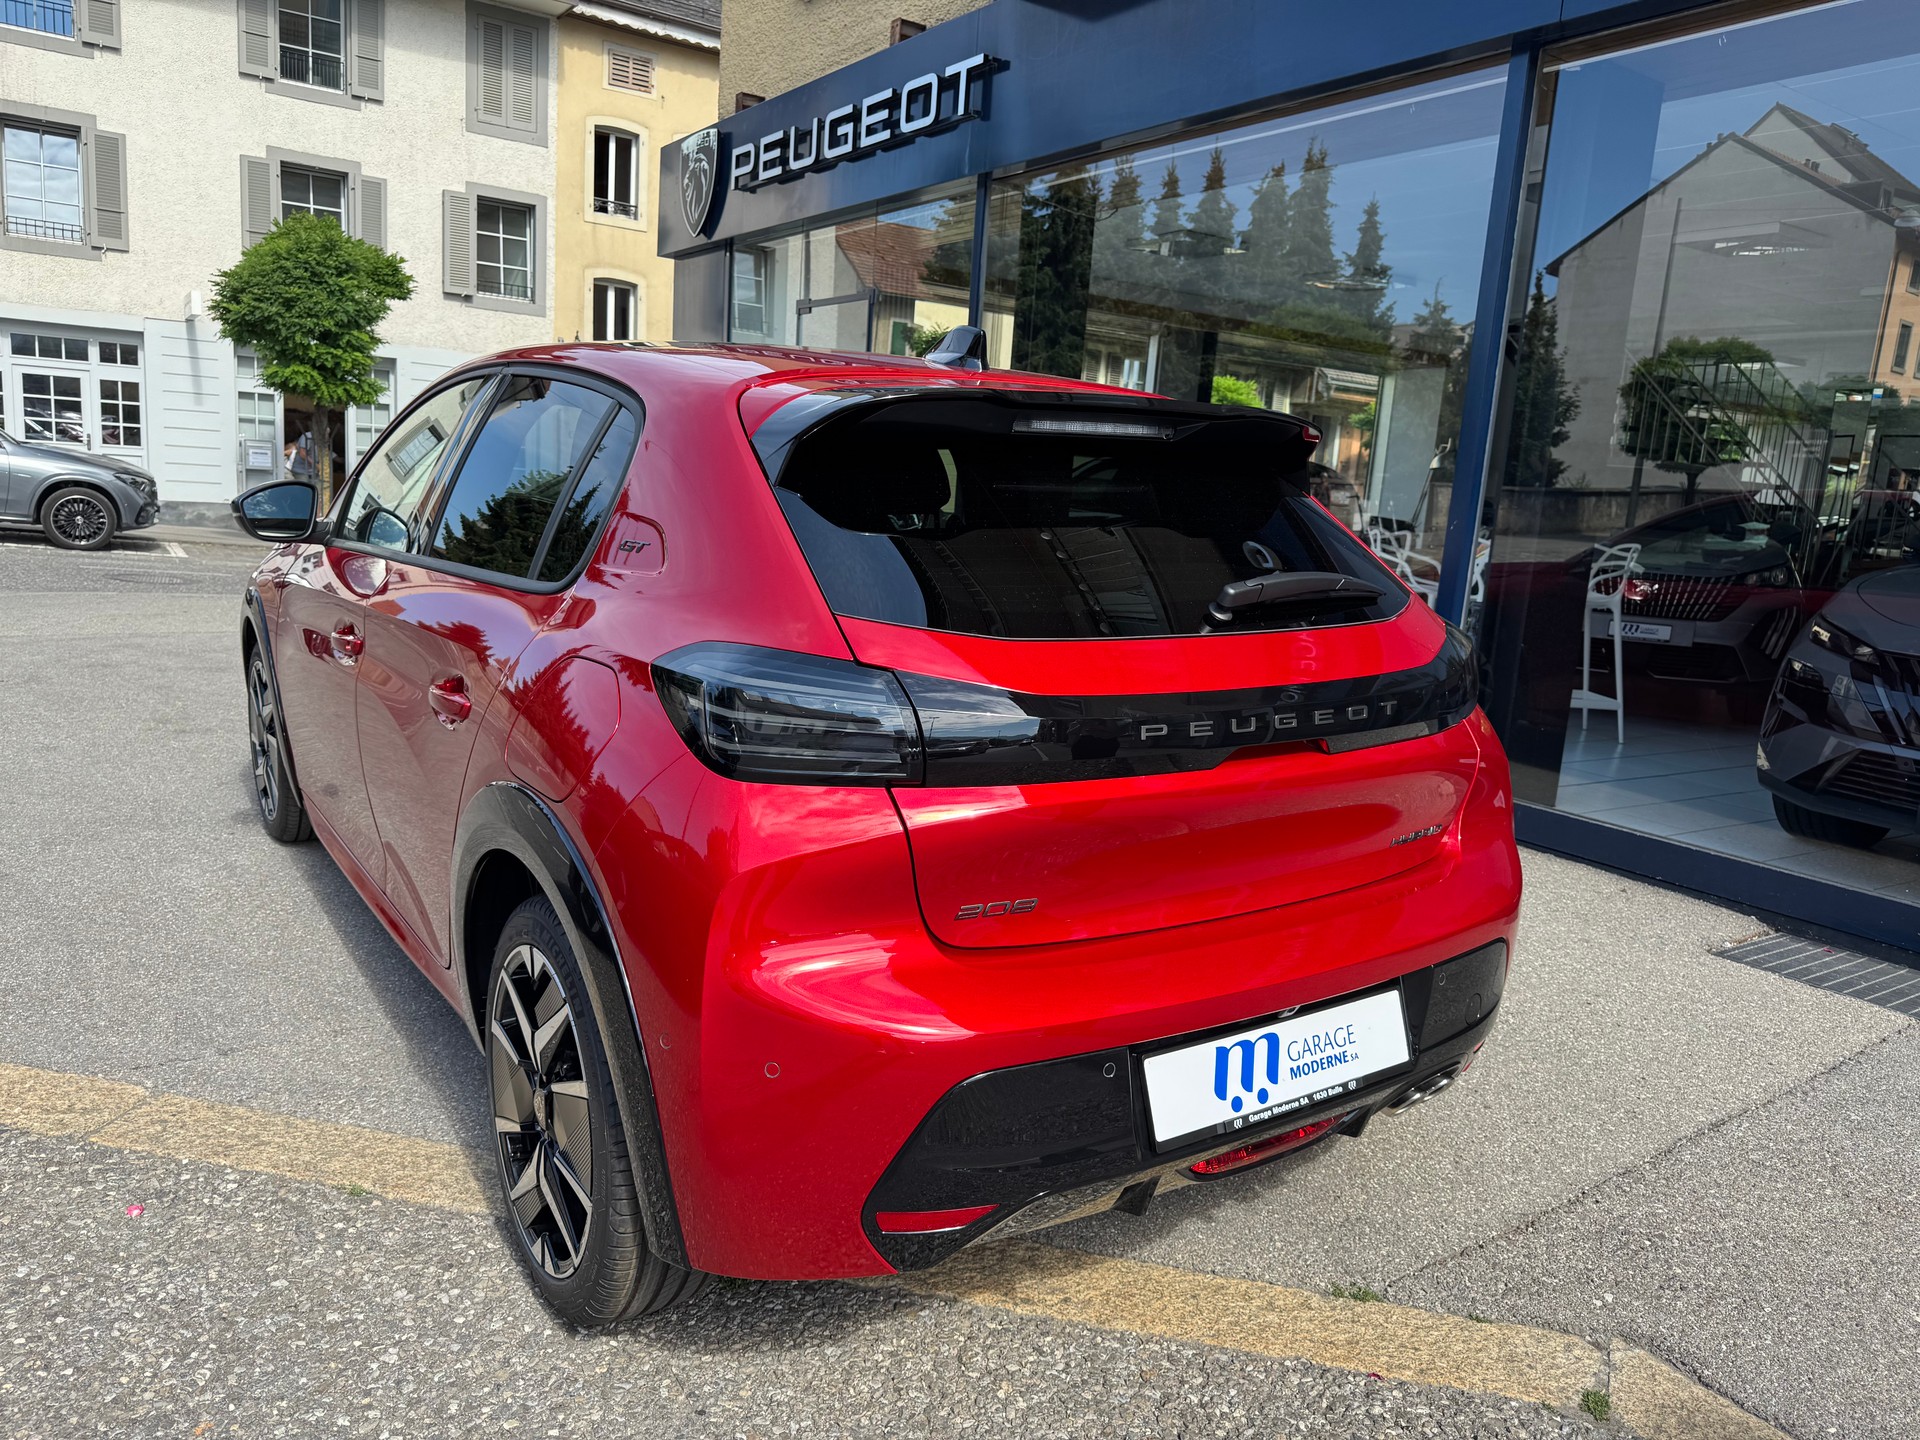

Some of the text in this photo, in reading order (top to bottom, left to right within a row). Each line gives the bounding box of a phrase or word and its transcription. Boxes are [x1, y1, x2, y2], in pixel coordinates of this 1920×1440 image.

[730, 53, 986, 191] PEUGEOT
[619, 539, 651, 553] GT
[1140, 700, 1398, 741] PEUGEOT
[954, 897, 1039, 921] 208
[538, 930, 585, 1019] MICHELIN
[1287, 1024, 1357, 1062] GARAGE
[1289, 1050, 1360, 1081] MODERNE SA
[1248, 1109, 1272, 1123] Garage
[1272, 1101, 1300, 1115] Moderne
[1300, 1097, 1310, 1106] SA
